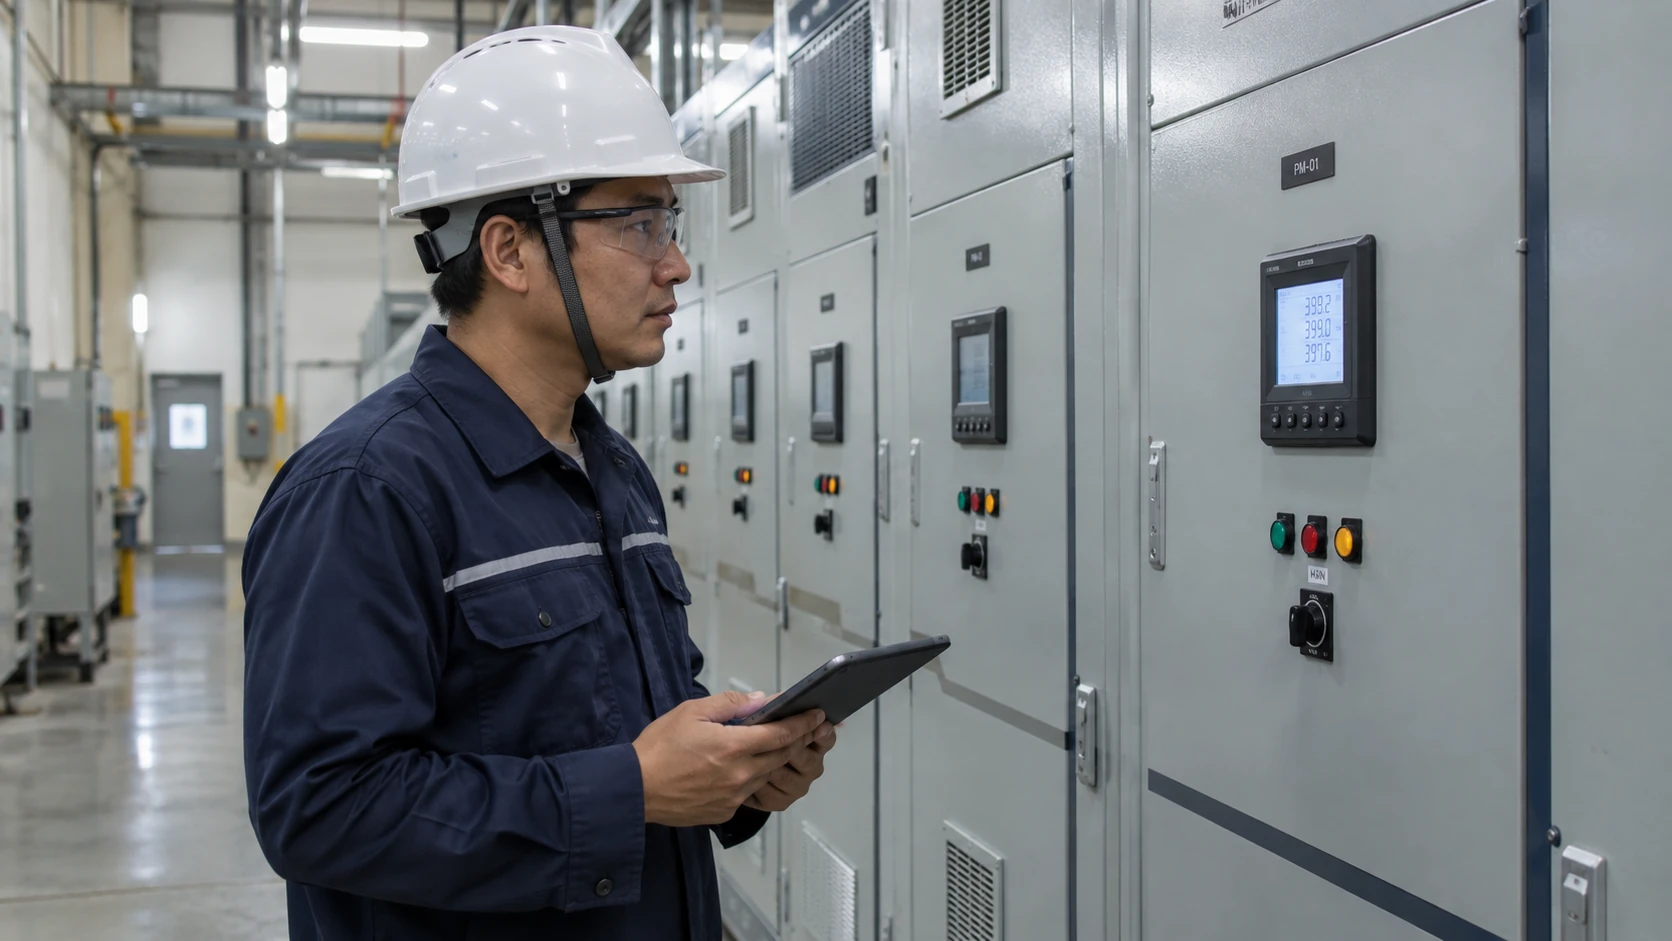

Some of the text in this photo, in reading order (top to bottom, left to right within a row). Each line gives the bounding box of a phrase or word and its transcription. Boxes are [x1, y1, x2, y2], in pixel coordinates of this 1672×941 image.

[1294, 157, 1319, 176] PM-01
[1305, 318, 1331, 339] 399.0
[1305, 342, 1331, 363] 397.6
